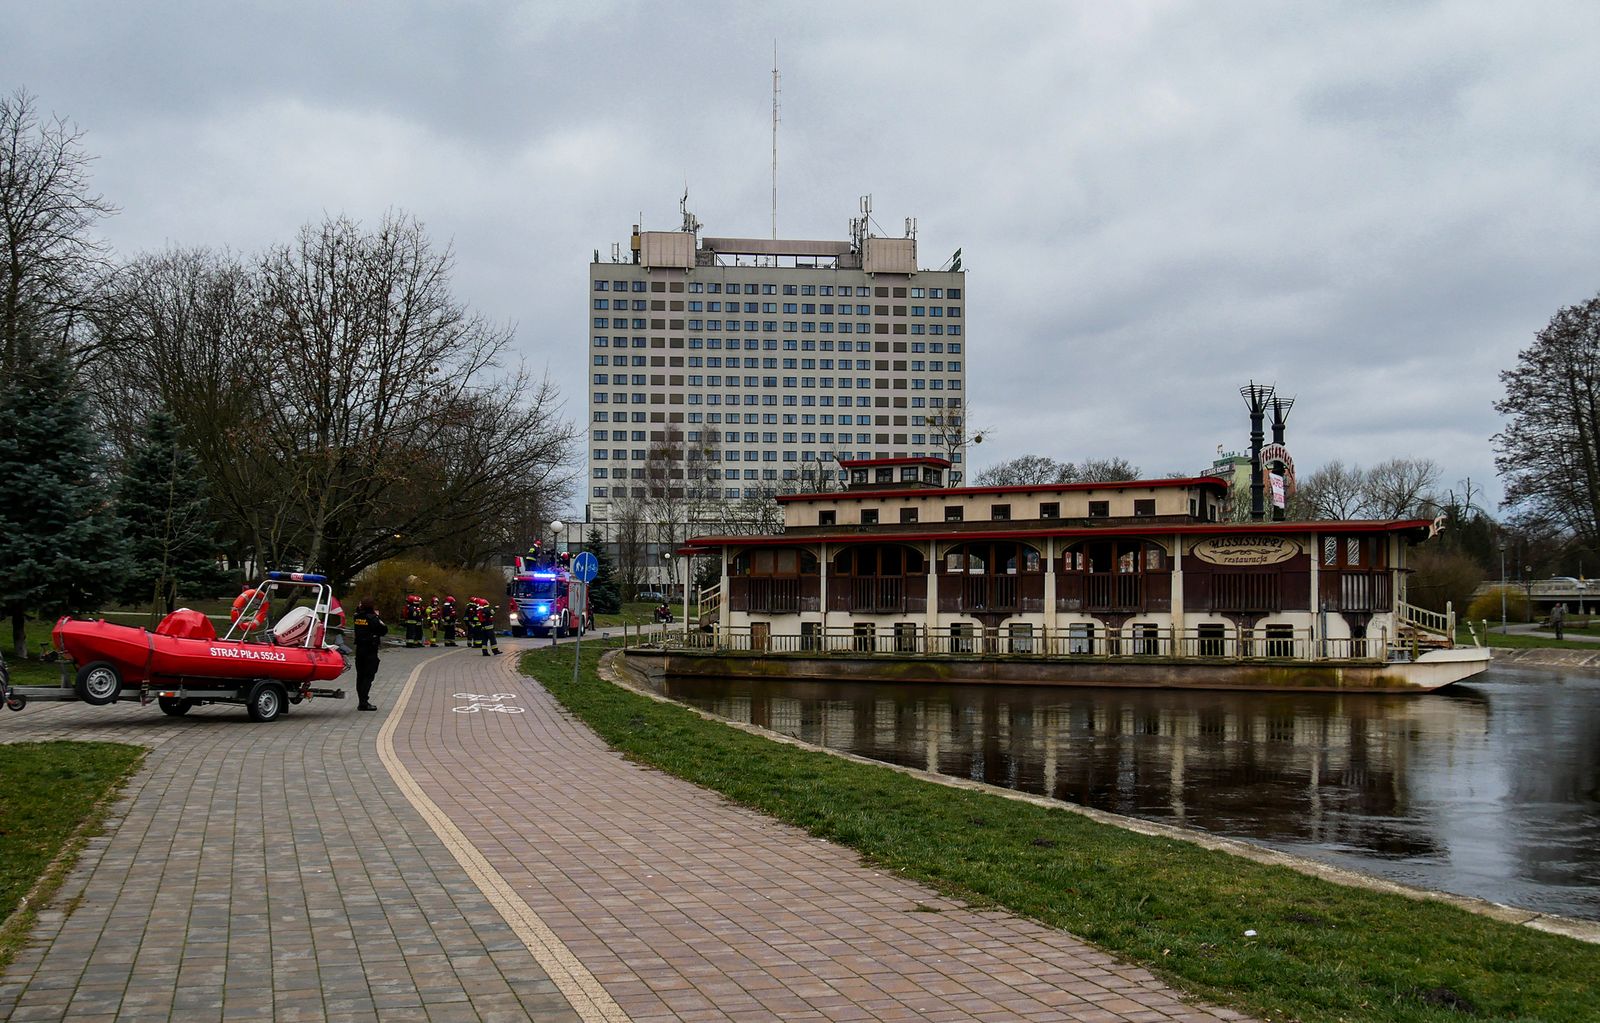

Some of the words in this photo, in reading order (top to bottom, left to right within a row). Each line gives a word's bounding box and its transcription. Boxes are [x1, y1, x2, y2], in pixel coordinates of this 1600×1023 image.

[1208, 536, 1285, 549] MISSISSIPPI
[1223, 555, 1267, 565] restauracja
[210, 647, 239, 658] STRAŻ
[240, 649, 260, 660] PIŁA
